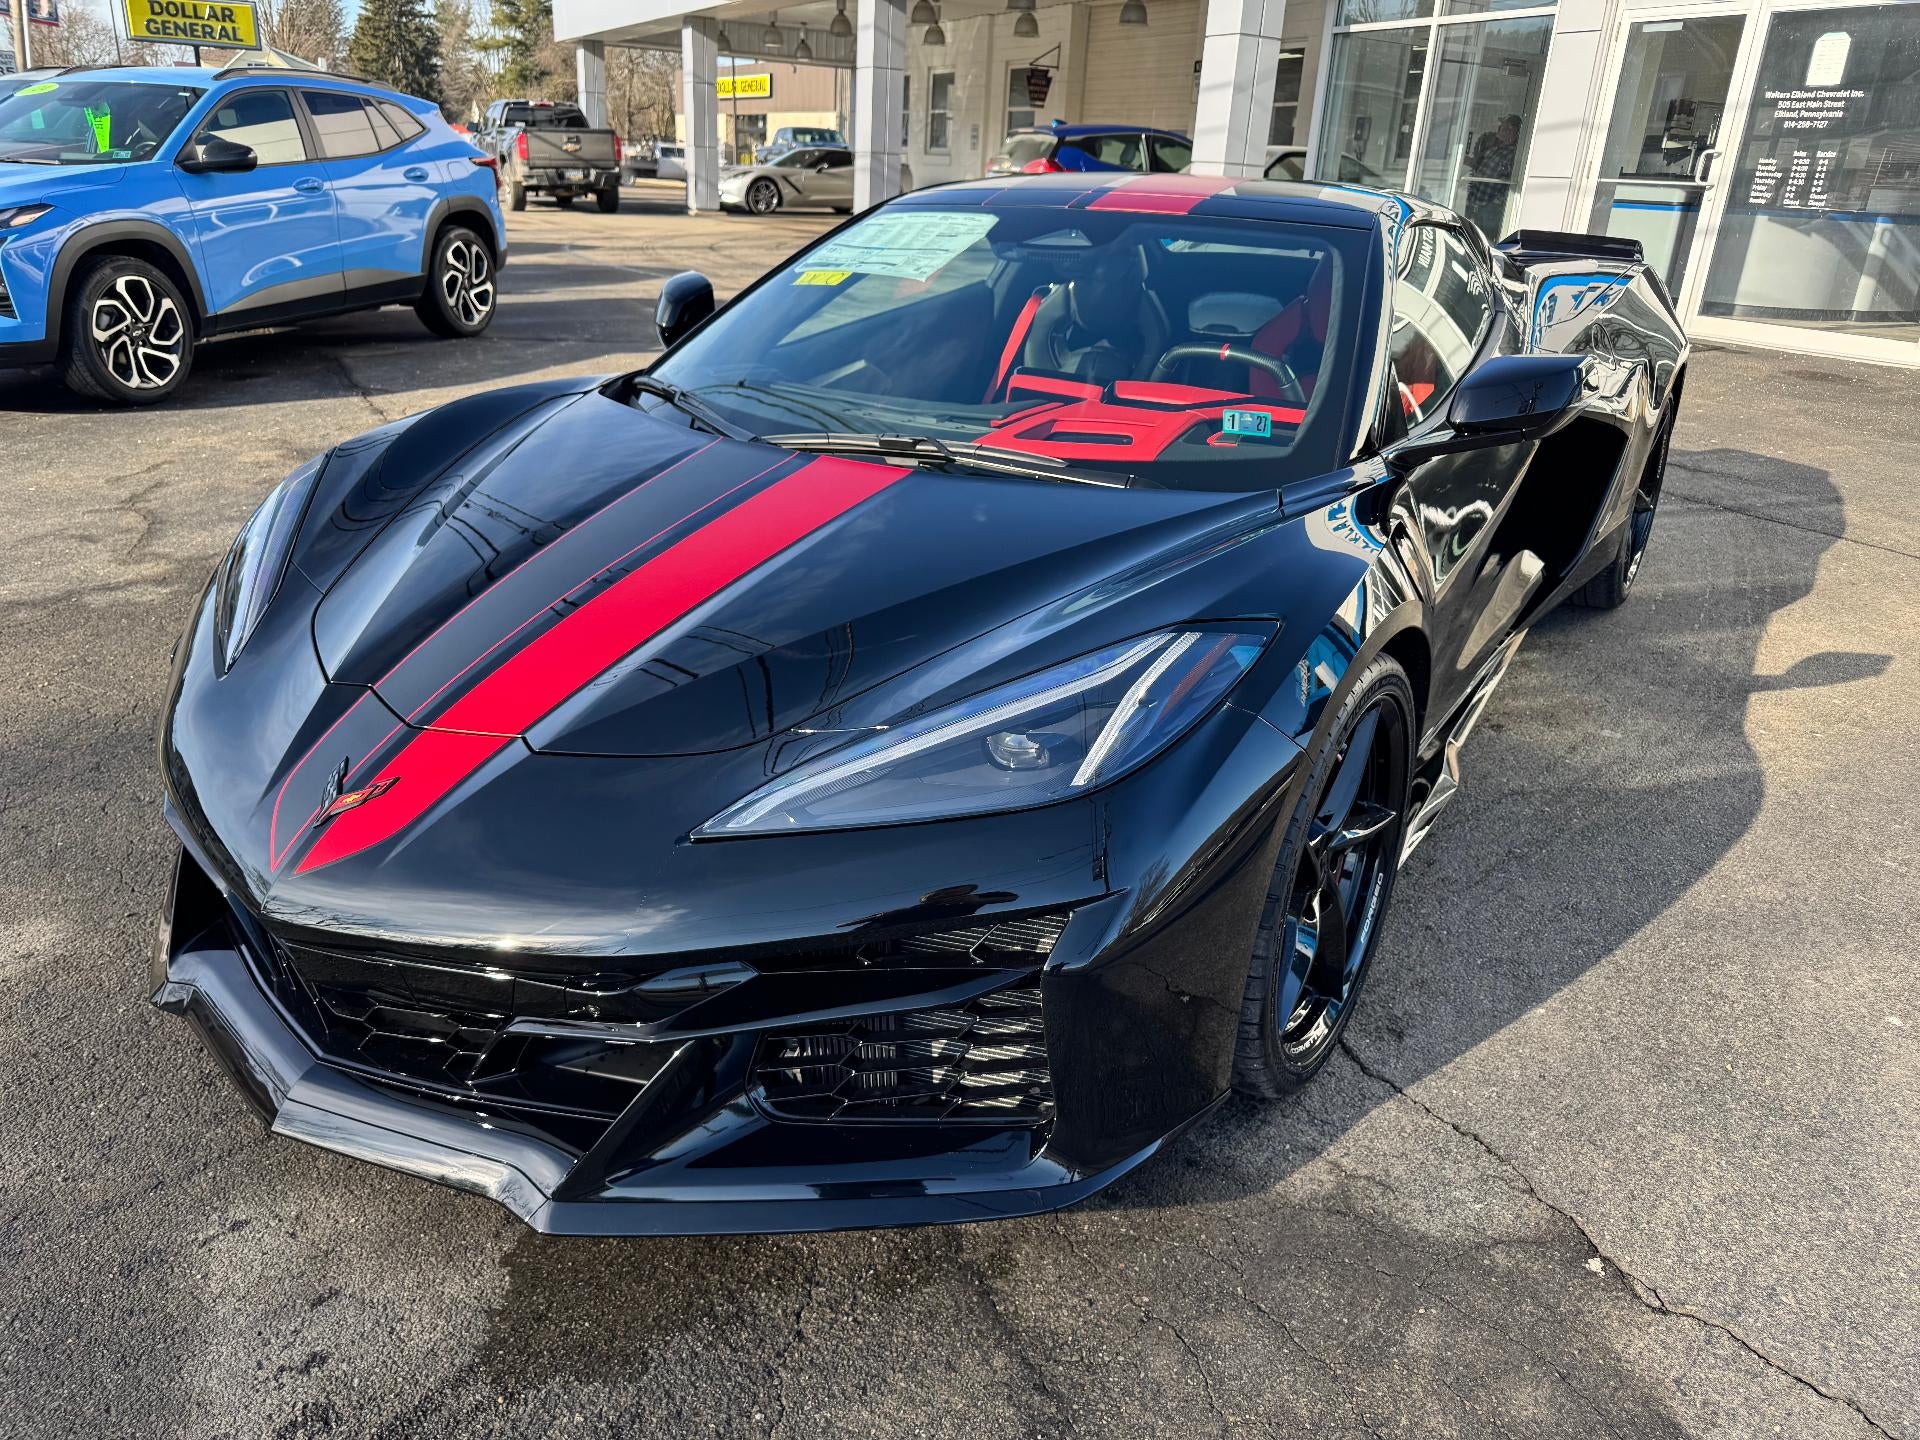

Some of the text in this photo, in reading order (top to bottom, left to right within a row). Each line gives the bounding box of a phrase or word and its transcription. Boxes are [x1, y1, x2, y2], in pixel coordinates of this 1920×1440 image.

[147, 0, 236, 23] DOLLAR
[145, 18, 244, 42] GENERAL
[1765, 90, 1791, 99] Walters
[1791, 90, 1816, 98] Elkland
[1816, 90, 1850, 98] Chevrolet
[1777, 101, 1791, 109] 505
[1806, 100, 1823, 108] Main
[1823, 100, 1845, 108] Street
[1774, 110, 1844, 119] Elkland, Pennsylvania
[1256, 415, 1268, 433] 27
[1360, 872, 1384, 944] FORGED
[1290, 1031, 1322, 1054] CORVETT
